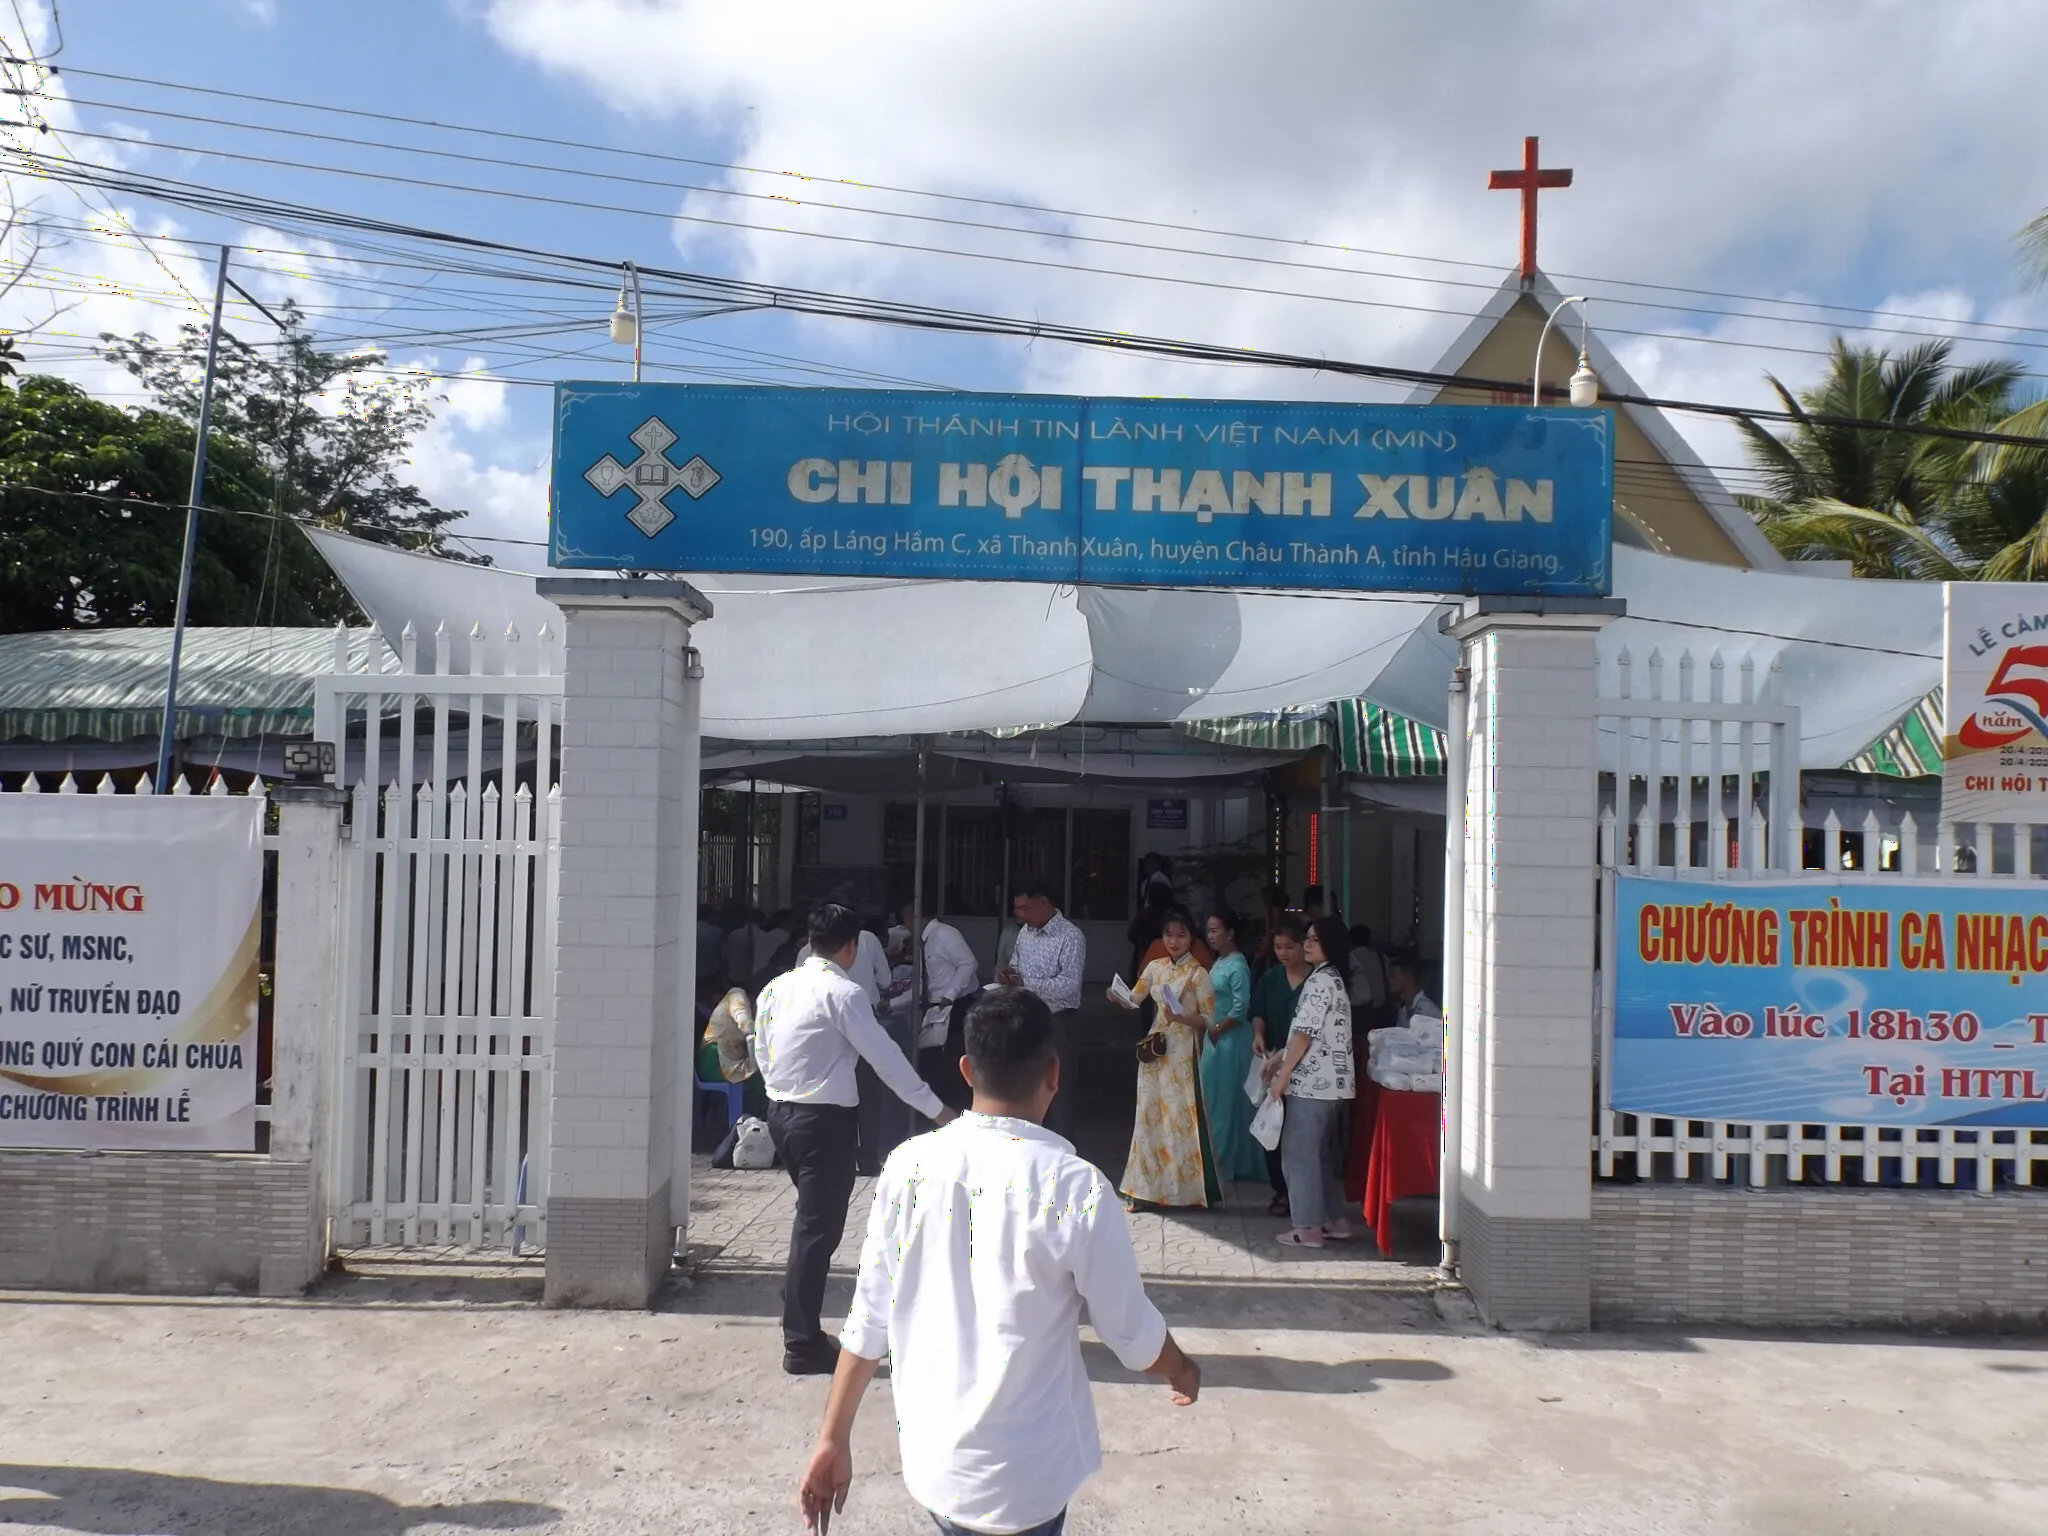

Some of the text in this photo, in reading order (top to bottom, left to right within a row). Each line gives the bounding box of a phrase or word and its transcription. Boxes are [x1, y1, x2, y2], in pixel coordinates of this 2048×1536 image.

[828, 411, 1457, 452] HỘI THÁNH TIN LÀNH VIỆT NAM (MN)
[787, 453, 1554, 524] CHI HỘI THẠNH XUÂN
[749, 526, 1564, 575] 190, ấp Láng Hầm C, xã Thạnh Xuân, huyện Châu Thành A, tỉnh Hậu Giang.
[1982, 711, 2023, 728] năm
[1965, 775, 1995, 791] CHI
[2001, 772, 2031, 795] HỘI
[33, 875, 144, 911] MỪNG
[20, 932, 54, 962] SƯ,
[62, 935, 134, 964] MSNC,
[1640, 898, 2048, 985] CHƯƠNG TRÌNH CA NHẠC
[10, 983, 43, 1012] NỮ
[137, 990, 181, 1020] ĐẠO
[1670, 1003, 1752, 1037] Vào
[1764, 1004, 1825, 1038] lúc
[1847, 1009, 1980, 1042] 18h30
[42, 1037, 83, 1069] QUÝ
[90, 1042, 135, 1067] CON
[142, 1038, 178, 1068] CÁI
[186, 1039, 243, 1069] CHÚA
[1862, 1065, 2048, 1105] Tại HTTL
[0, 1088, 190, 1122] CHƯƠNG TRÌNH LỄ
